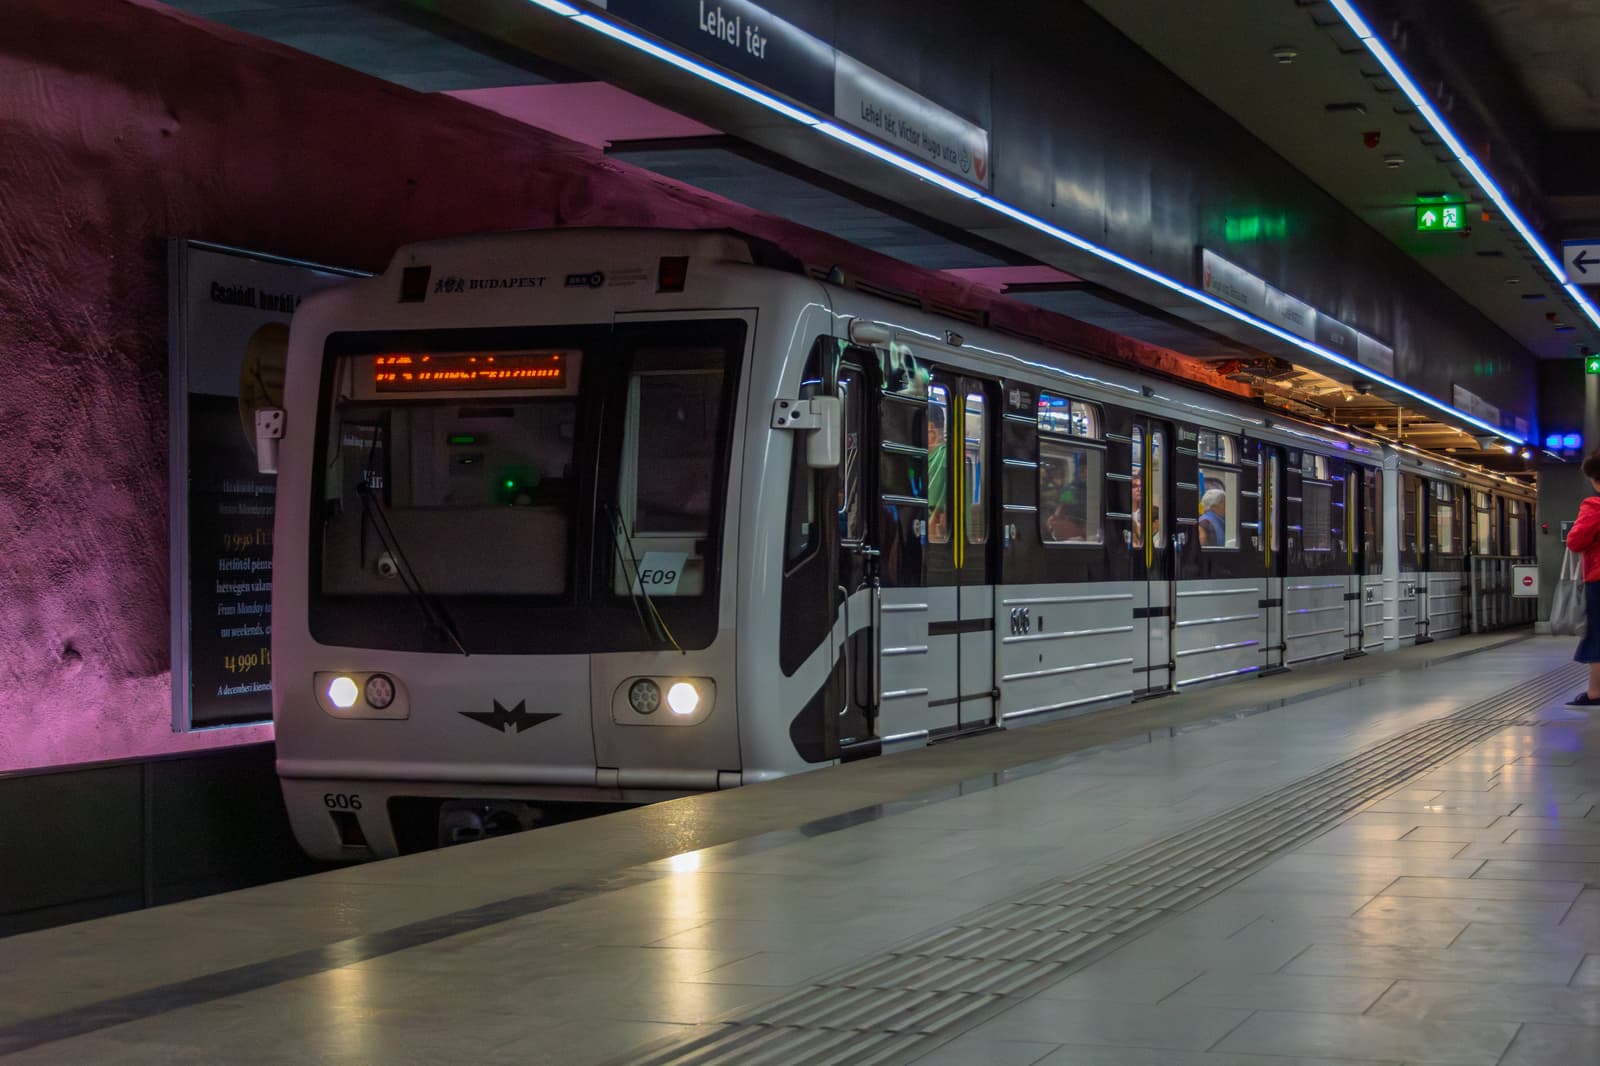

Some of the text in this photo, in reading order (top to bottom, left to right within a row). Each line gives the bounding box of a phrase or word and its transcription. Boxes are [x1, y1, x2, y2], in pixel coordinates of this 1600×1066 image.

[700, 0, 767, 59] Lehel tér
[860, 100, 882, 128] Lehel
[898, 120, 920, 146] Victor
[922, 132, 941, 160] Hugo
[942, 146, 957, 164] utca
[469, 277, 546, 289] BUDAPEST
[640, 570, 677, 585] E09
[323, 793, 362, 810] 606
